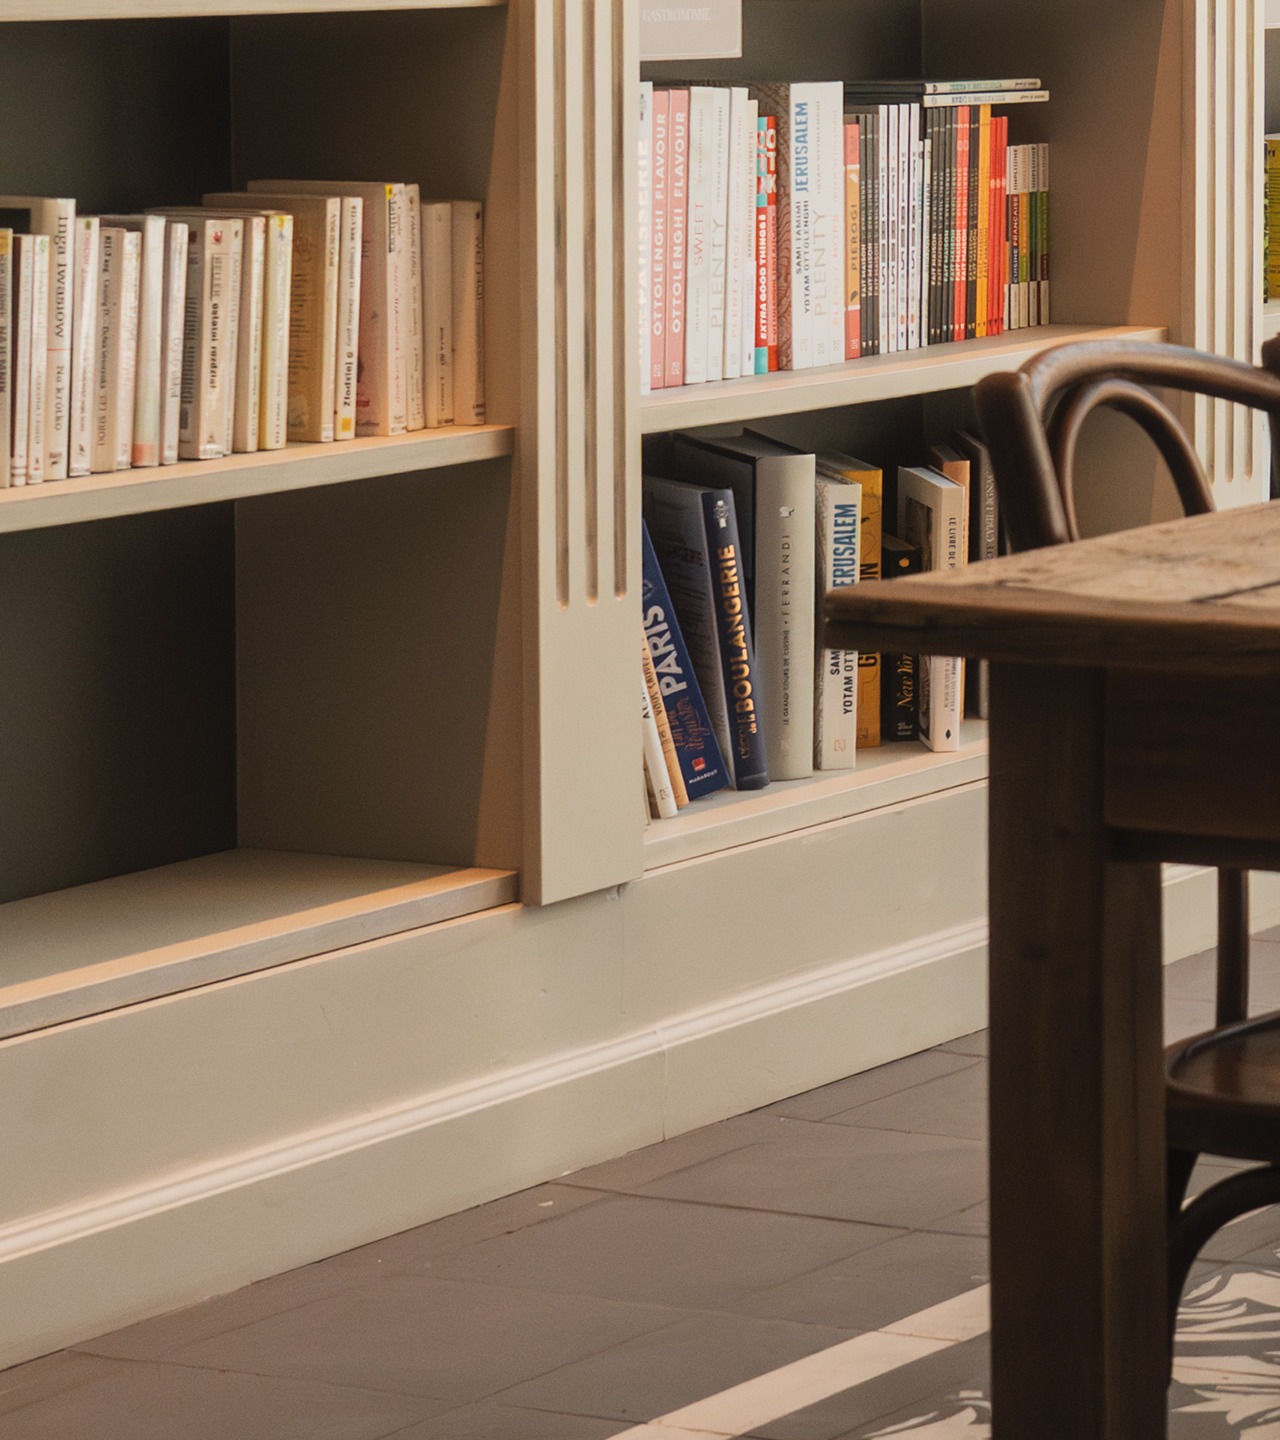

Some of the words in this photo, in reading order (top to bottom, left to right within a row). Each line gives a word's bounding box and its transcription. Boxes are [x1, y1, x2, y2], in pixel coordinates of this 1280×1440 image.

[641, 6, 712, 24] GASTRONOMIE
[656, 113, 665, 200] FLAVOUR
[674, 112, 685, 198] FLAVOUR
[795, 102, 808, 193] JERUSALEM
[55, 216, 69, 256] Inga
[652, 209, 664, 336] OTTOLENGHI
[672, 207, 683, 334] OTTOLENGHI
[693, 203, 705, 267] SWEET
[711, 218, 724, 330] PLENTY
[814, 209, 827, 318] PLENTY
[832, 214, 840, 258] MORE
[758, 305, 767, 340] EXTRA
[759, 267, 767, 303] GOOD
[782, 534, 791, 617] FERRANDI
[833, 503, 857, 588] ERUSALEM
[716, 543, 755, 714] BOULANGERIE
[830, 650, 840, 675] SAM
[843, 676, 854, 714] YOTAM
